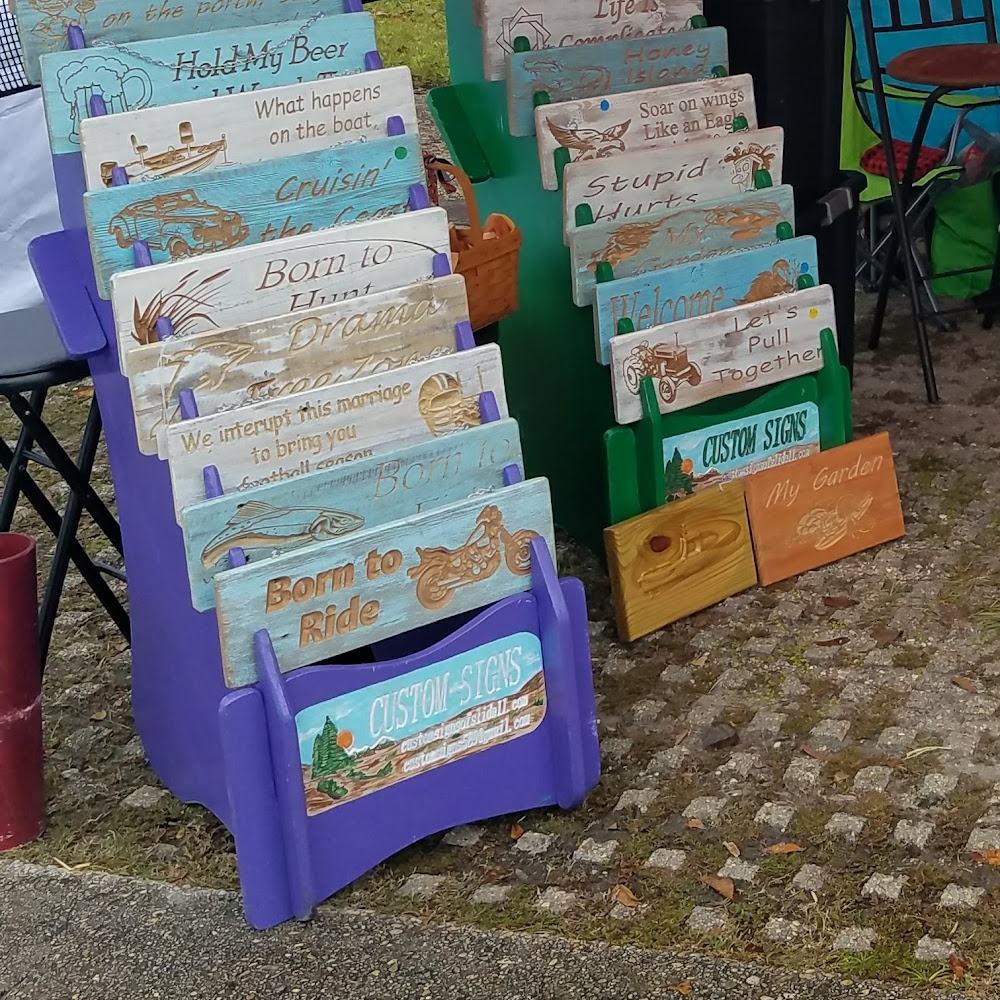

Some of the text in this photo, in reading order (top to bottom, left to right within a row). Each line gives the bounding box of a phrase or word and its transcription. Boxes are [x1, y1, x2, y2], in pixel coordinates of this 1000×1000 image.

[102, 9, 130, 29] on
[146, 0, 184, 22] the
[559, 22, 692, 48] Complicate
[172, 35, 349, 82] Hold My Beer
[624, 42, 712, 65] Honey
[255, 84, 381, 120] What happens
[639, 88, 745, 119] Soar on wings
[269, 129, 290, 145] on
[296, 120, 327, 140] the
[643, 121, 680, 141] Like
[683, 119, 700, 133] an
[583, 157, 709, 198] Stupid
[593, 191, 700, 224] Hurts
[255, 243, 393, 291] Born to
[289, 298, 448, 353] Drama
[610, 286, 725, 332] Welcome
[734, 304, 798, 333] Let's
[749, 327, 789, 353] Pull
[713, 345, 823, 385] Together
[181, 427, 213, 454] We
[298, 398, 331, 426] this
[336, 381, 412, 414] marriage
[702, 408, 808, 468] CUSTOM SIGNS
[250, 424, 357, 465] to bring you
[372, 451, 462, 499] Born
[766, 455, 884, 509] My Garden
[265, 548, 402, 614] Born to
[299, 594, 381, 648] Ride
[369, 646, 523, 738] CUSTOM SIGNS
